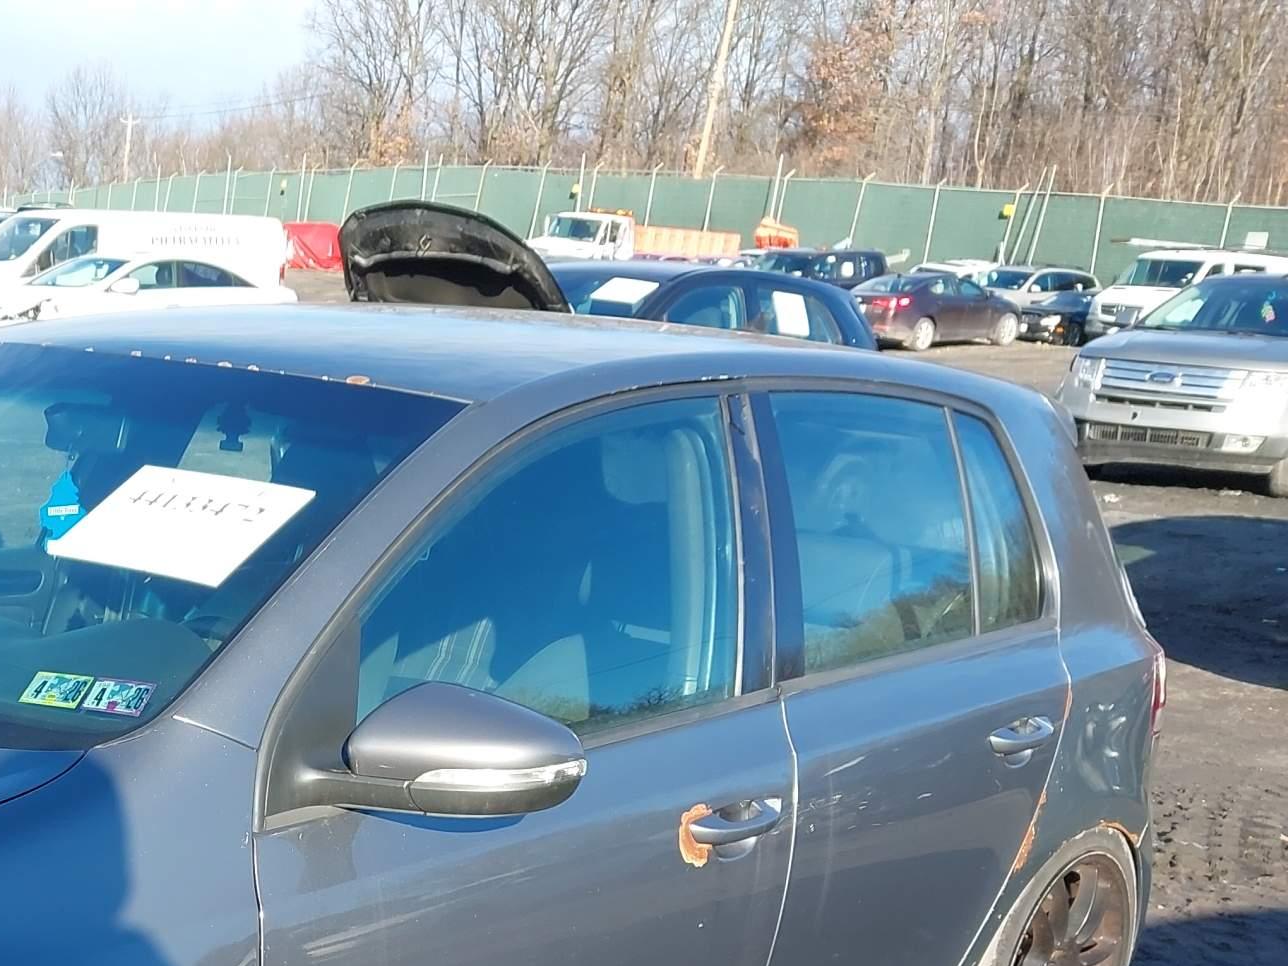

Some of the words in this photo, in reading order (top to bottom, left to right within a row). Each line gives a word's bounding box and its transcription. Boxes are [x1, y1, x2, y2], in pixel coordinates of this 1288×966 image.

[32, 680, 49, 699] 4
[64, 680, 88, 703] 26
[94, 687, 108, 707] 4
[125, 687, 150, 709] 26
